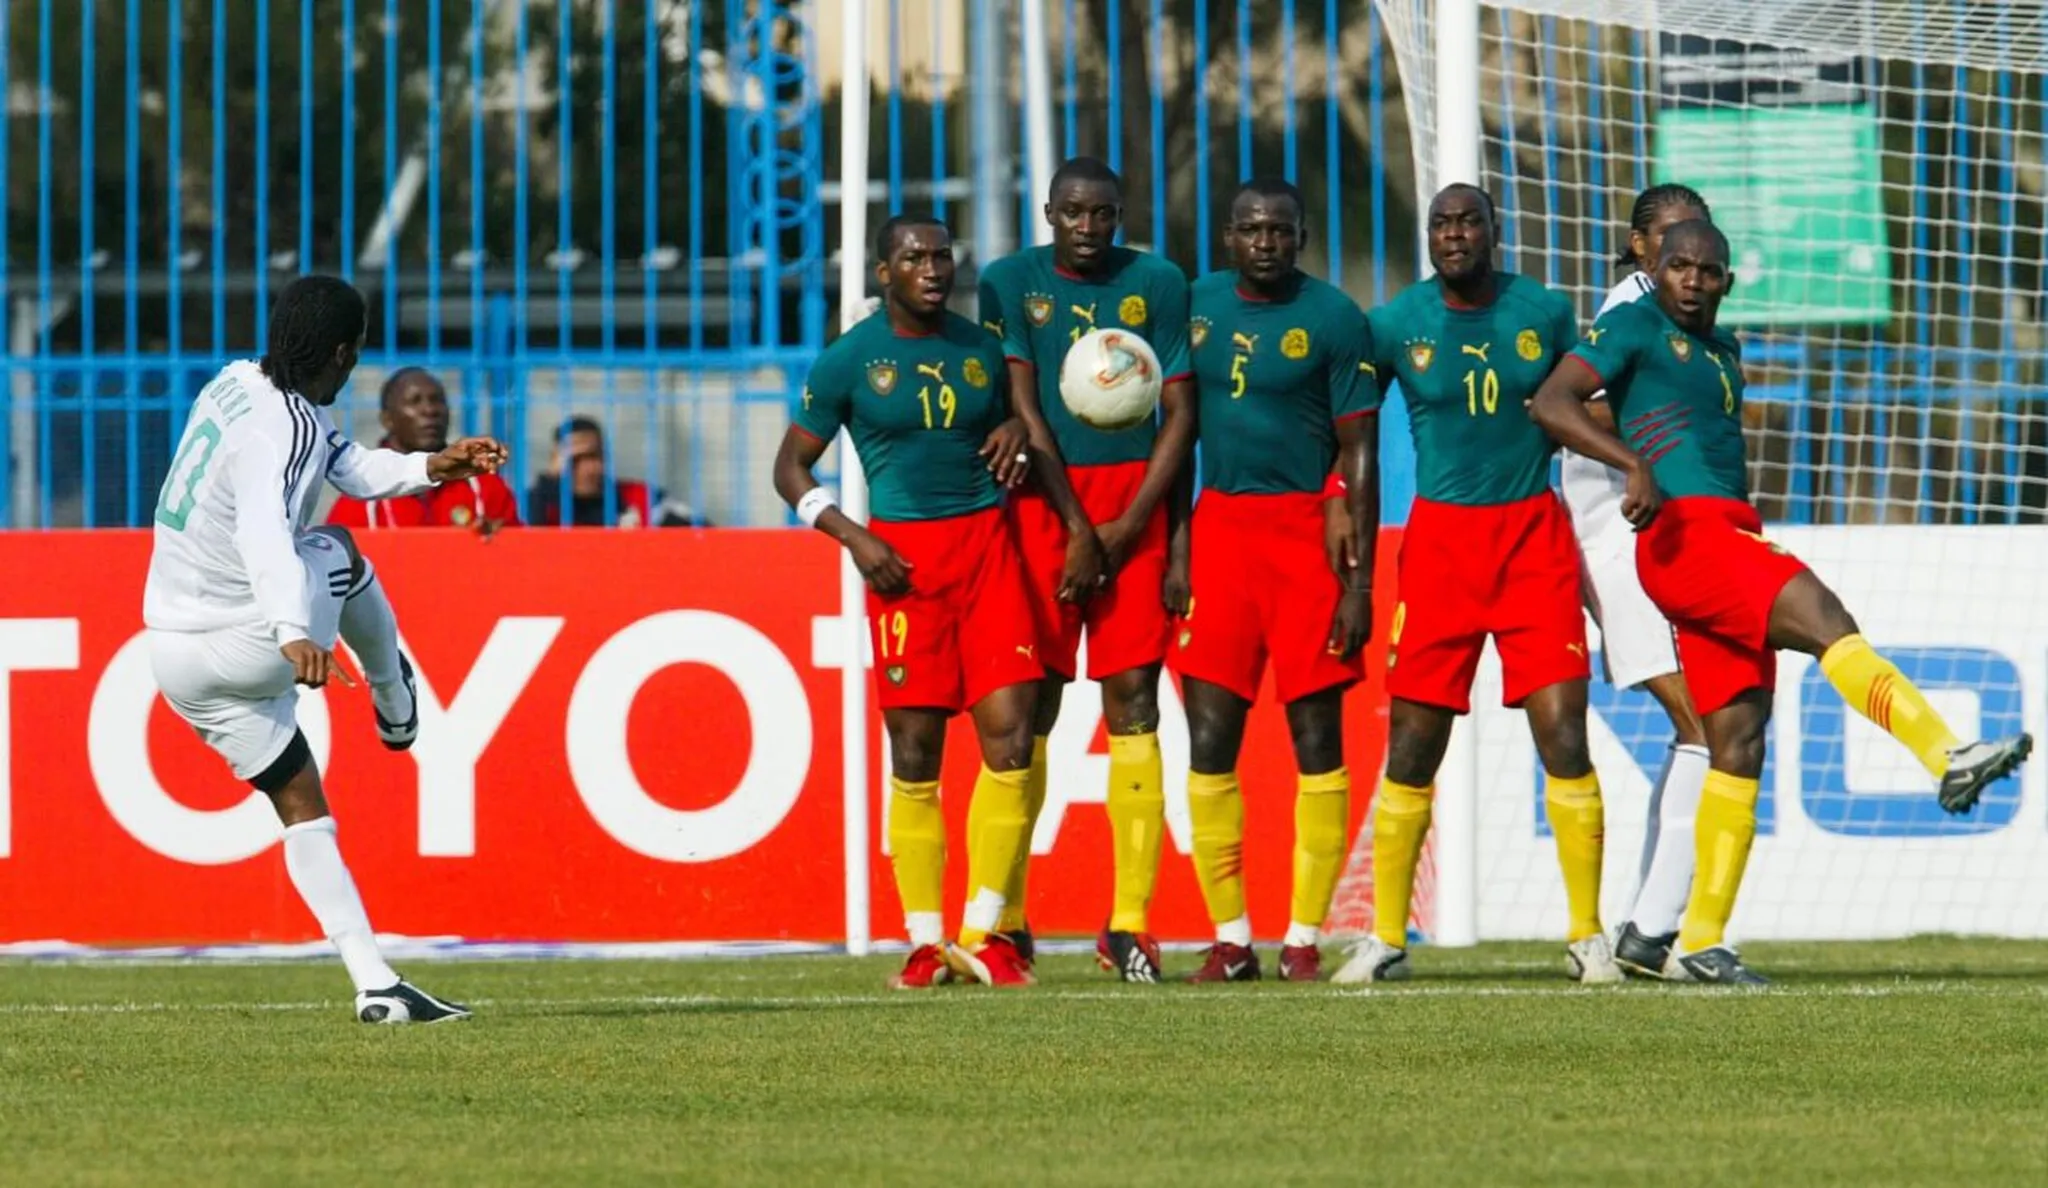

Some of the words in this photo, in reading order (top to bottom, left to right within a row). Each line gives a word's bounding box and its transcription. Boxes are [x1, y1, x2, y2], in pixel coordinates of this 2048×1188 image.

[1231, 353, 1248, 399] 5
[1463, 368, 1499, 416] 10
[918, 384, 956, 430] 19
[878, 610, 908, 659] 19
